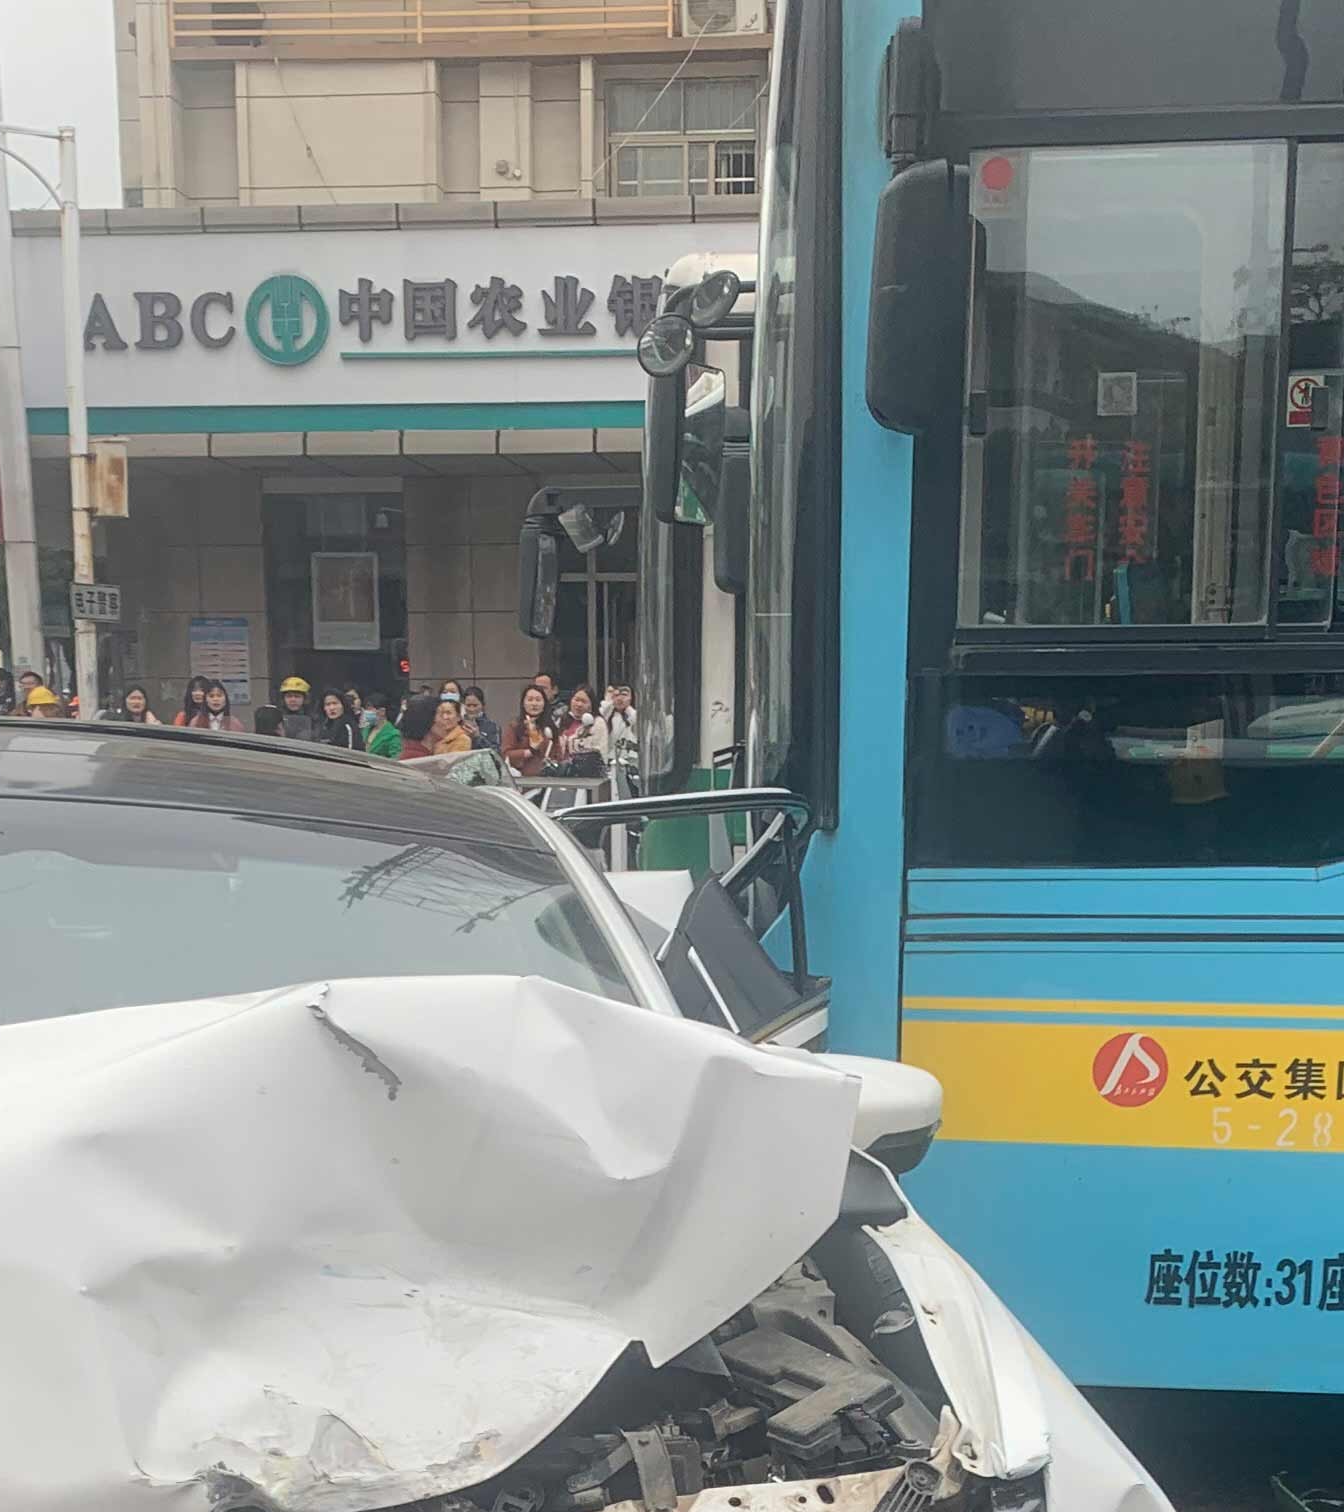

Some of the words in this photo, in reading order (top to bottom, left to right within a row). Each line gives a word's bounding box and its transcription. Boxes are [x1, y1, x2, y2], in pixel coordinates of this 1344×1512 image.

[82, 290, 236, 352] ABC
[338, 270, 669, 343] 中国农业银
